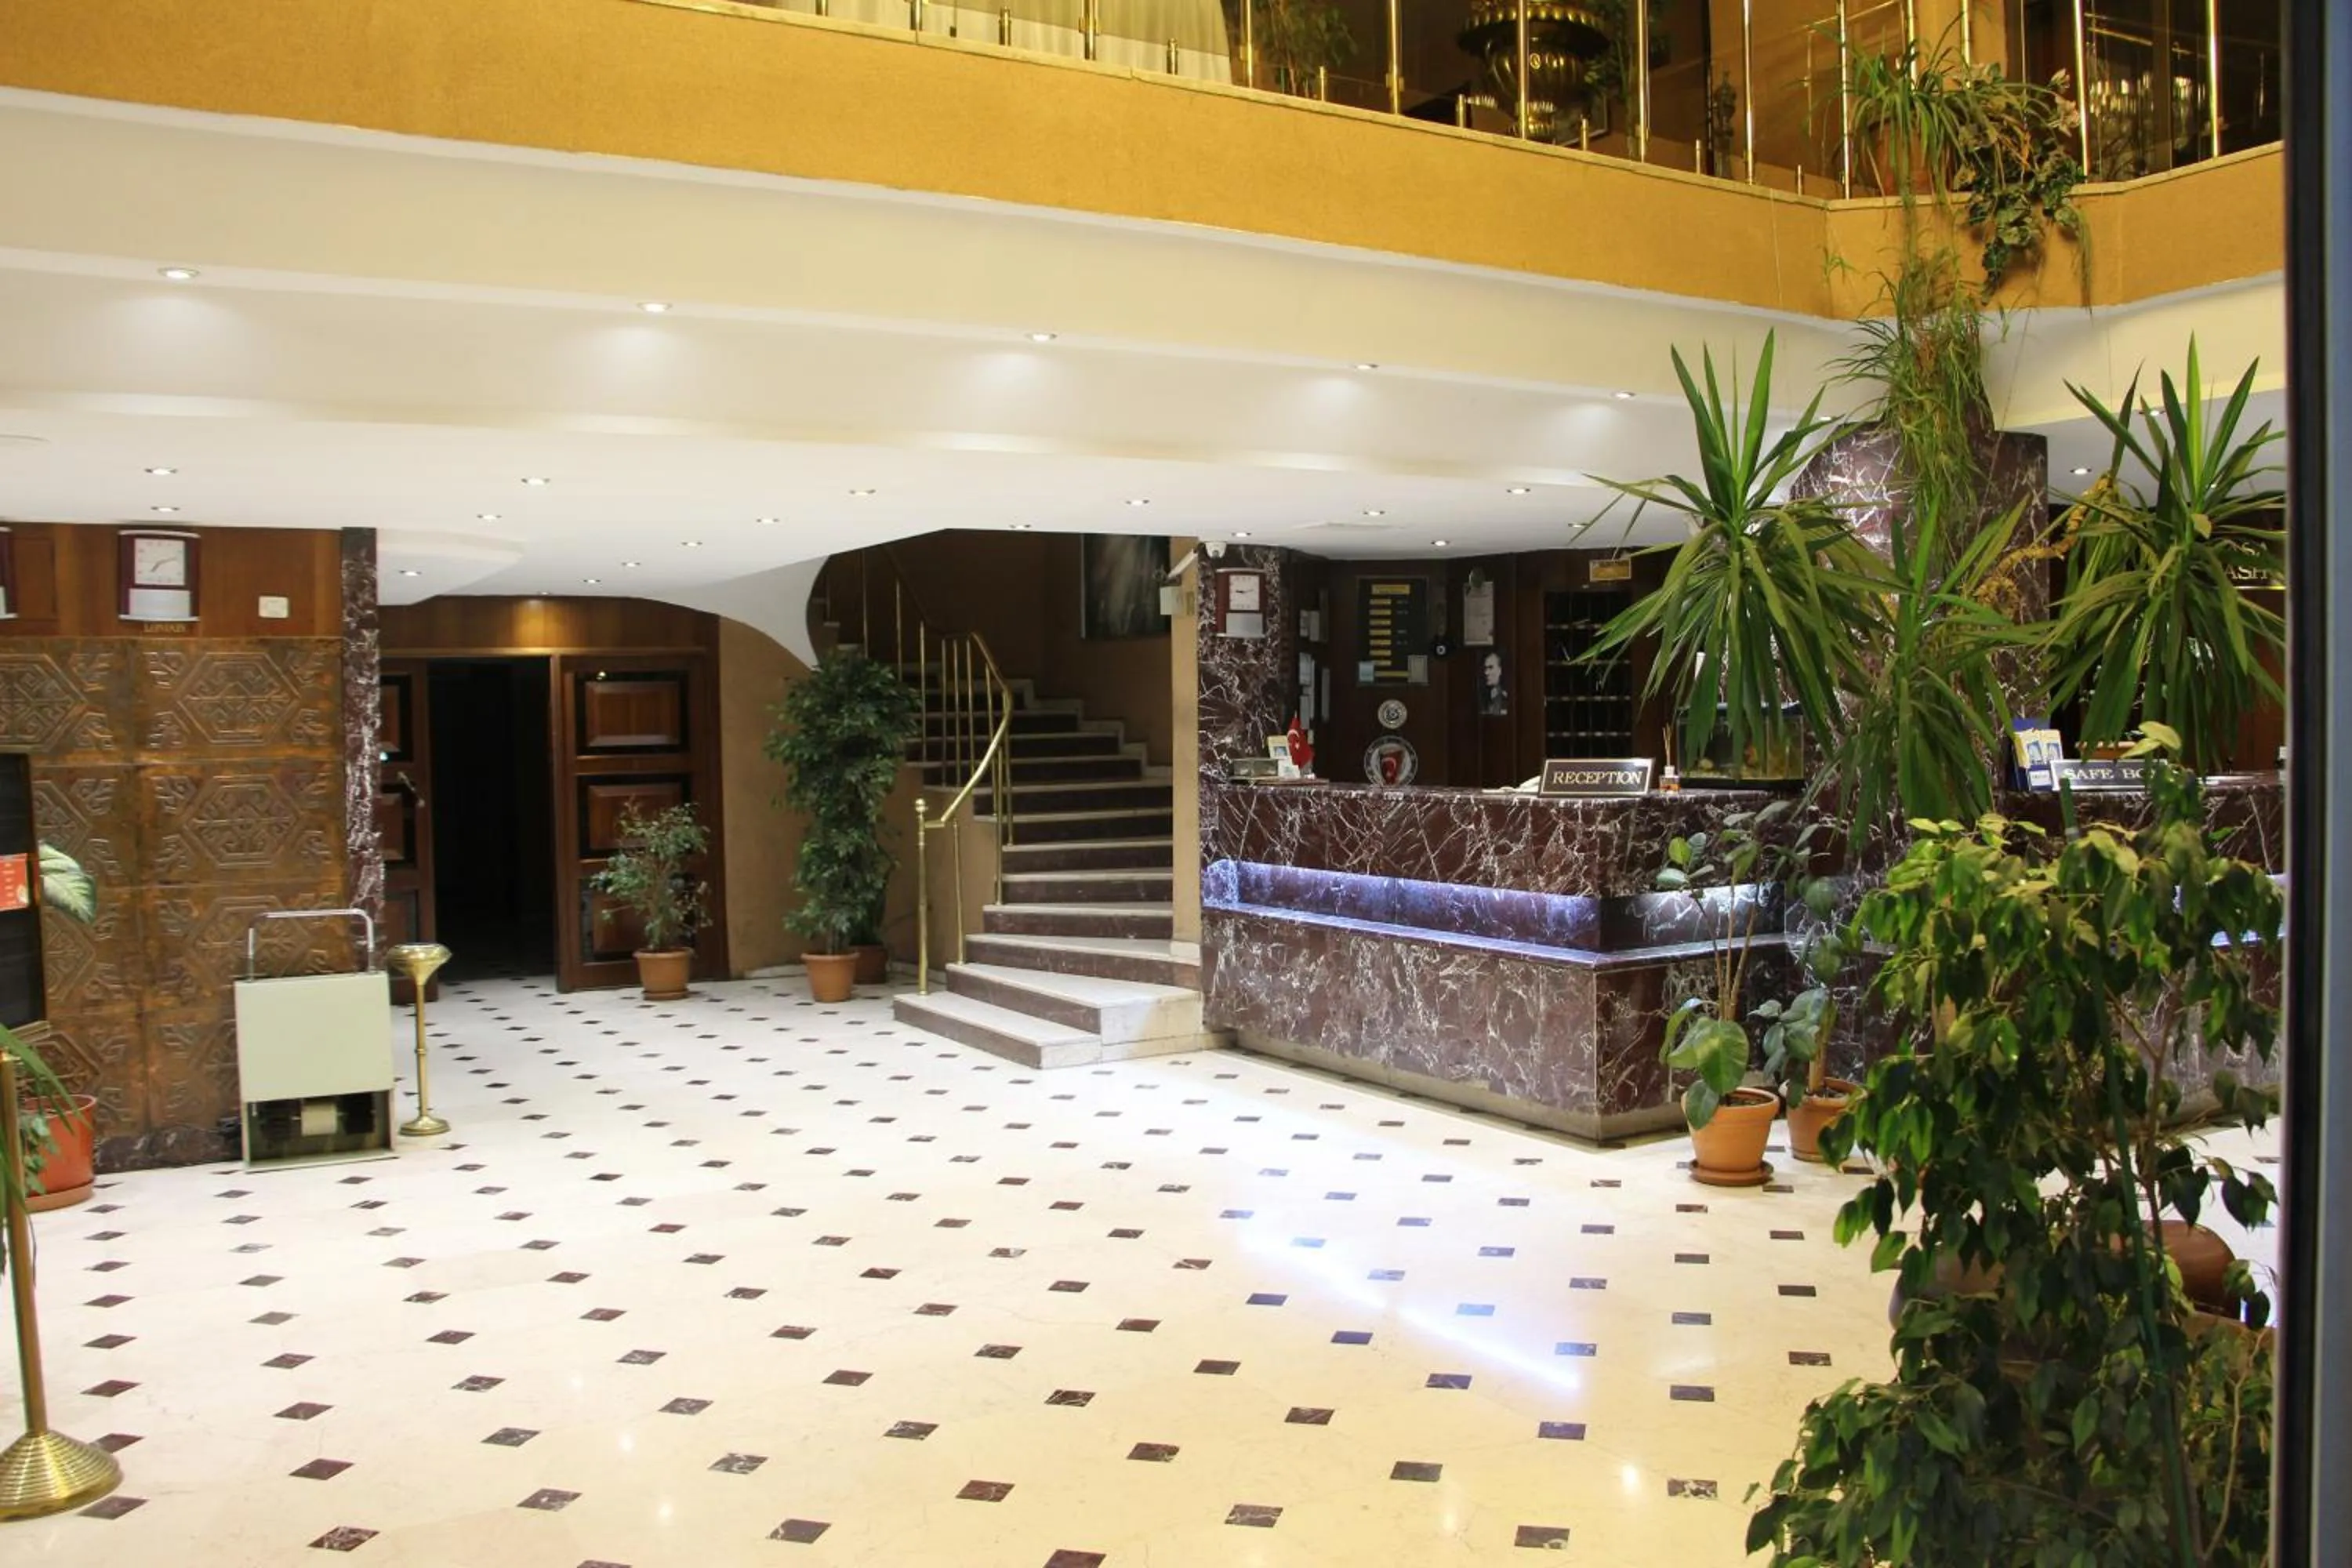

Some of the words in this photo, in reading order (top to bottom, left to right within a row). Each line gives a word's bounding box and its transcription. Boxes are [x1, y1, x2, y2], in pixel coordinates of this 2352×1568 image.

[1553, 771, 1643, 784] RECEPTION
[2063, 768, 2114, 779] SAFE
[2122, 768, 2156, 779] BO
